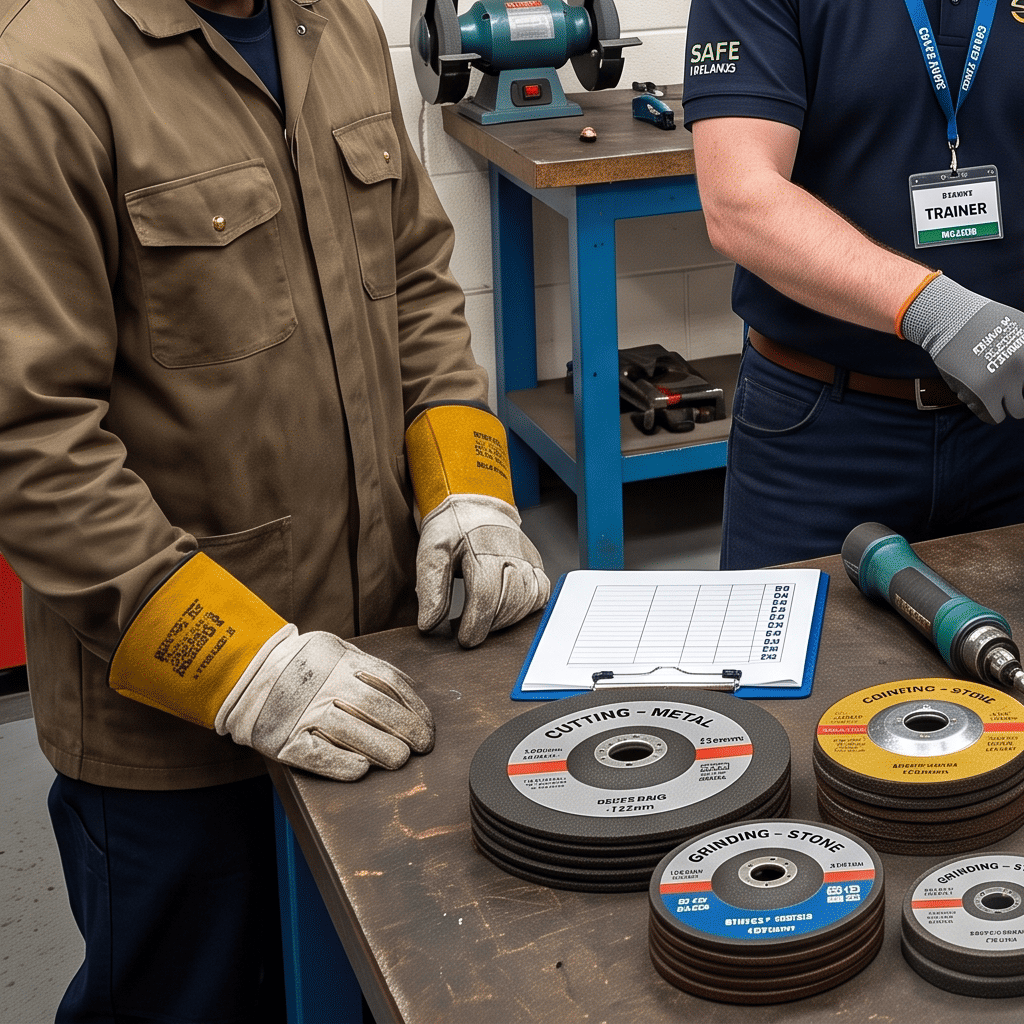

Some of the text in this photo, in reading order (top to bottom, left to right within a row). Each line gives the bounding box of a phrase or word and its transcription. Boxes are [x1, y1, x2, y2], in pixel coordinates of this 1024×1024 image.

[690, 41, 740, 63] SAFE
[925, 203, 987, 220] TRAINER
[544, 708, 630, 739] CUTTING
[651, 707, 715, 728] METAL
[688, 829, 769, 863] GRINDING
[788, 829, 845, 853] STONE
